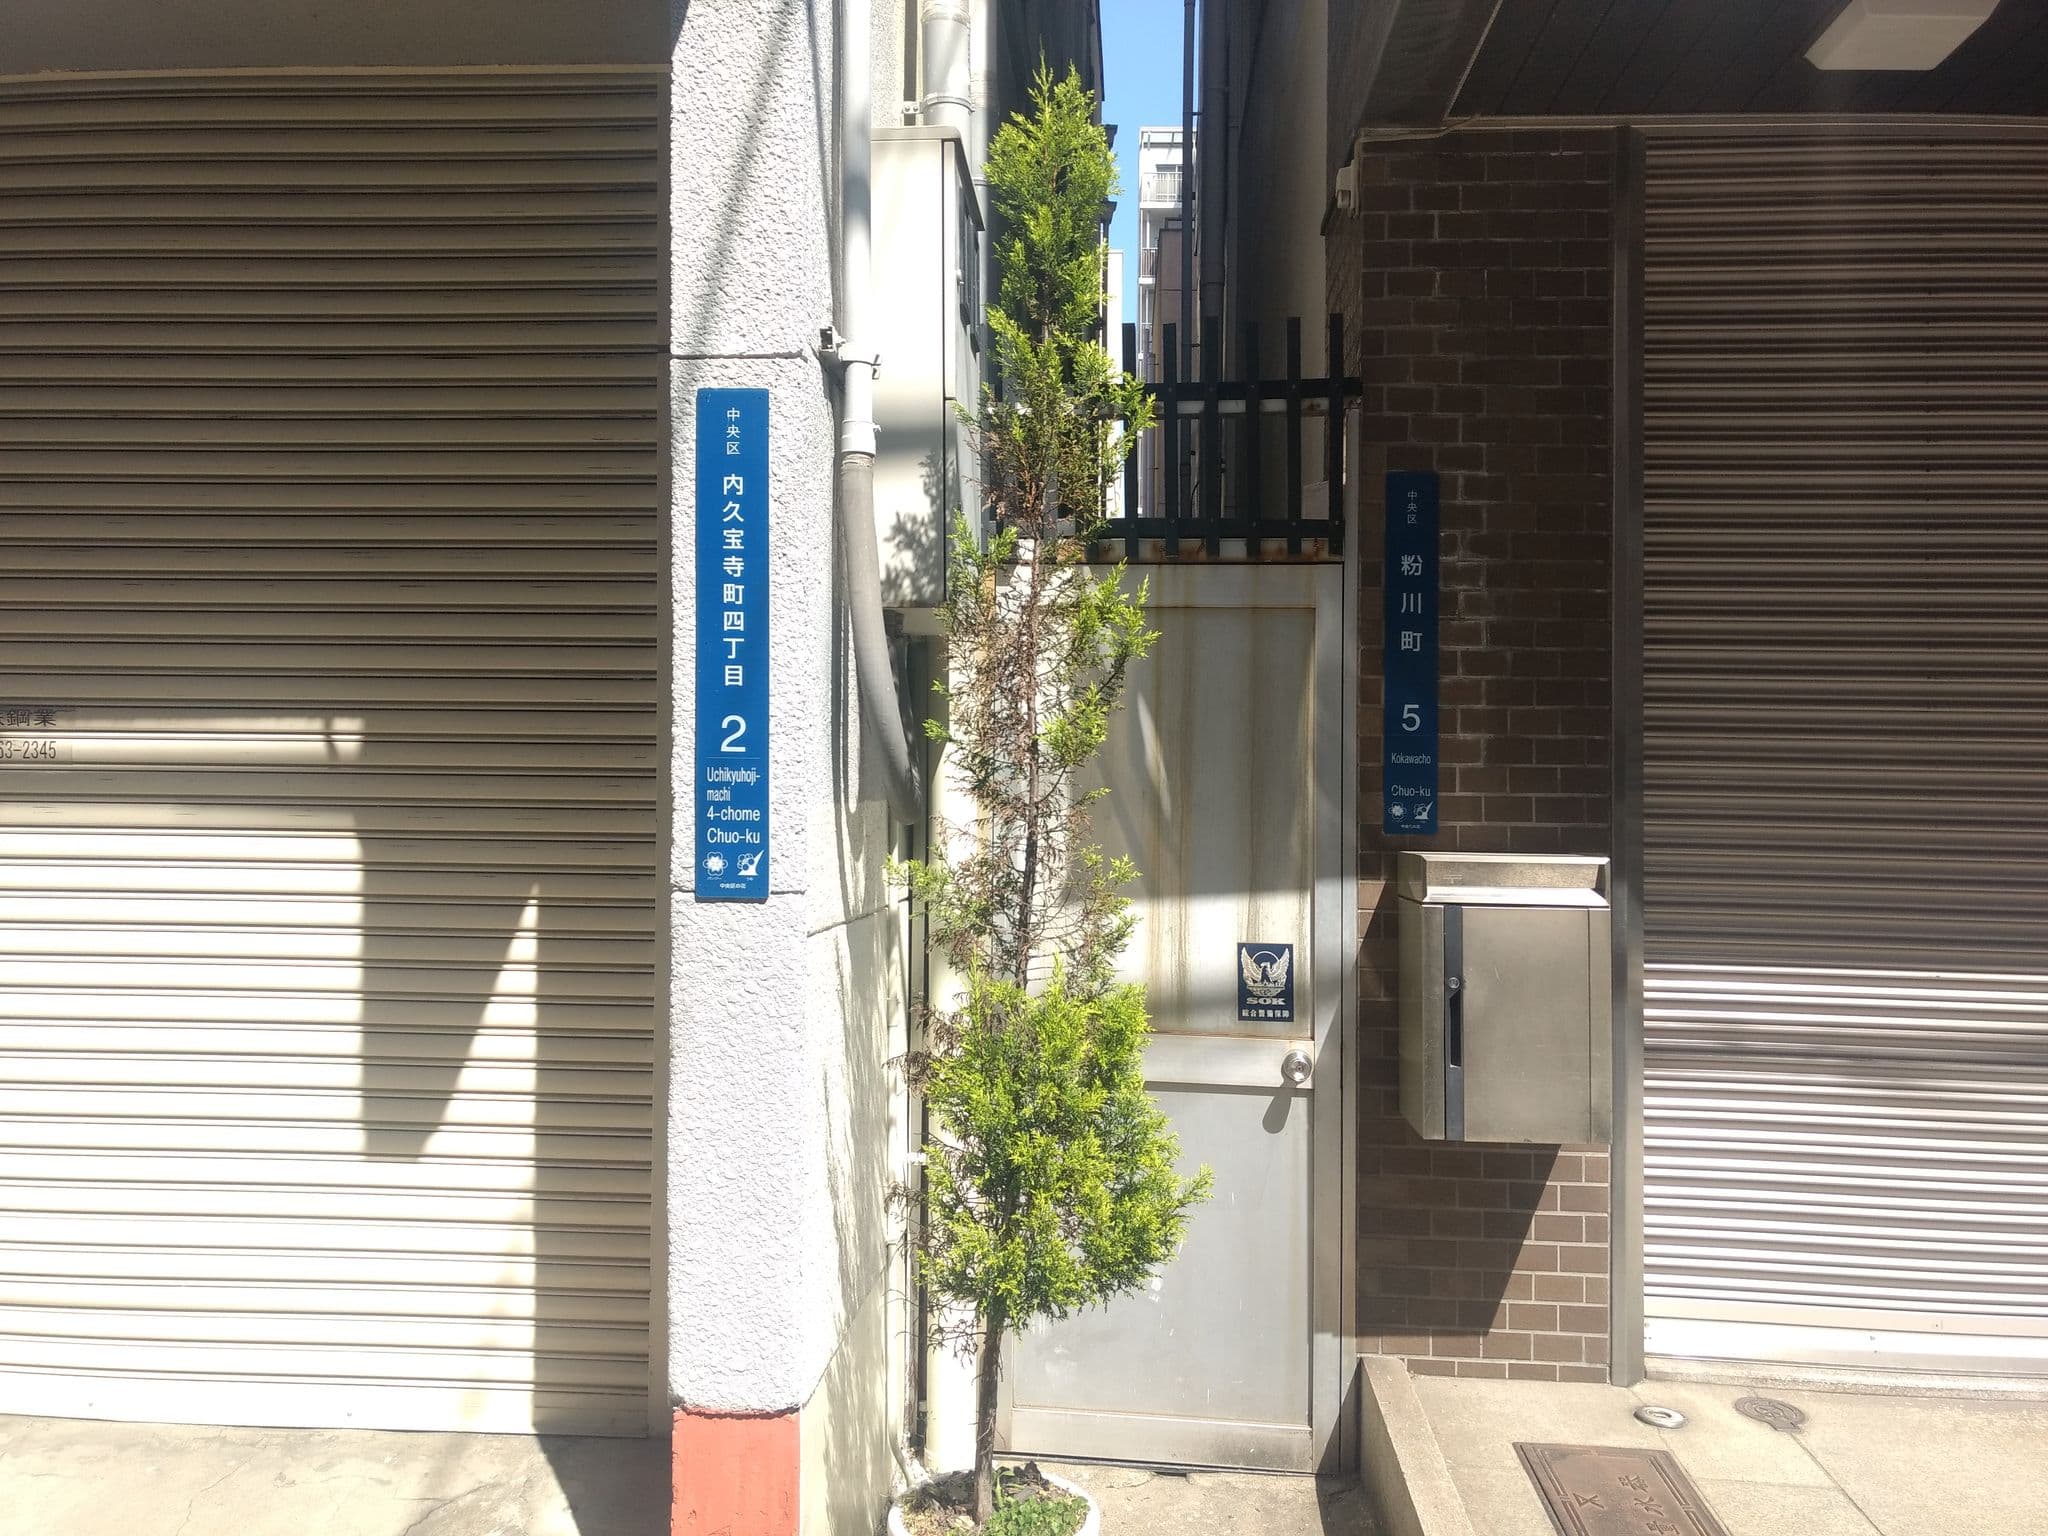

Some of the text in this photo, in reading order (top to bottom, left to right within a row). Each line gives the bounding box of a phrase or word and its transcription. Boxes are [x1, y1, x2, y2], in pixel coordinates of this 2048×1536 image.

[726, 408, 741, 455] 中央区
[1407, 490, 1418, 524] 中央区
[722, 474, 745, 686] 内久宝寺町四丁目
[1402, 554, 1423, 652] 粉川町
[0, 708, 57, 727] 鋼業
[1402, 704, 1421, 732] 5
[720, 715, 747, 753] 2
[1391, 752, 1432, 764] Kokawacho
[706, 766, 761, 786] Uchikyuhoji-
[706, 787, 731, 801] machi
[1391, 785, 1431, 797] Chuo-ku
[706, 806, 761, 821] 4-chome
[706, 828, 761, 844] Chuo-ku
[1246, 997, 1286, 1005] SOK
